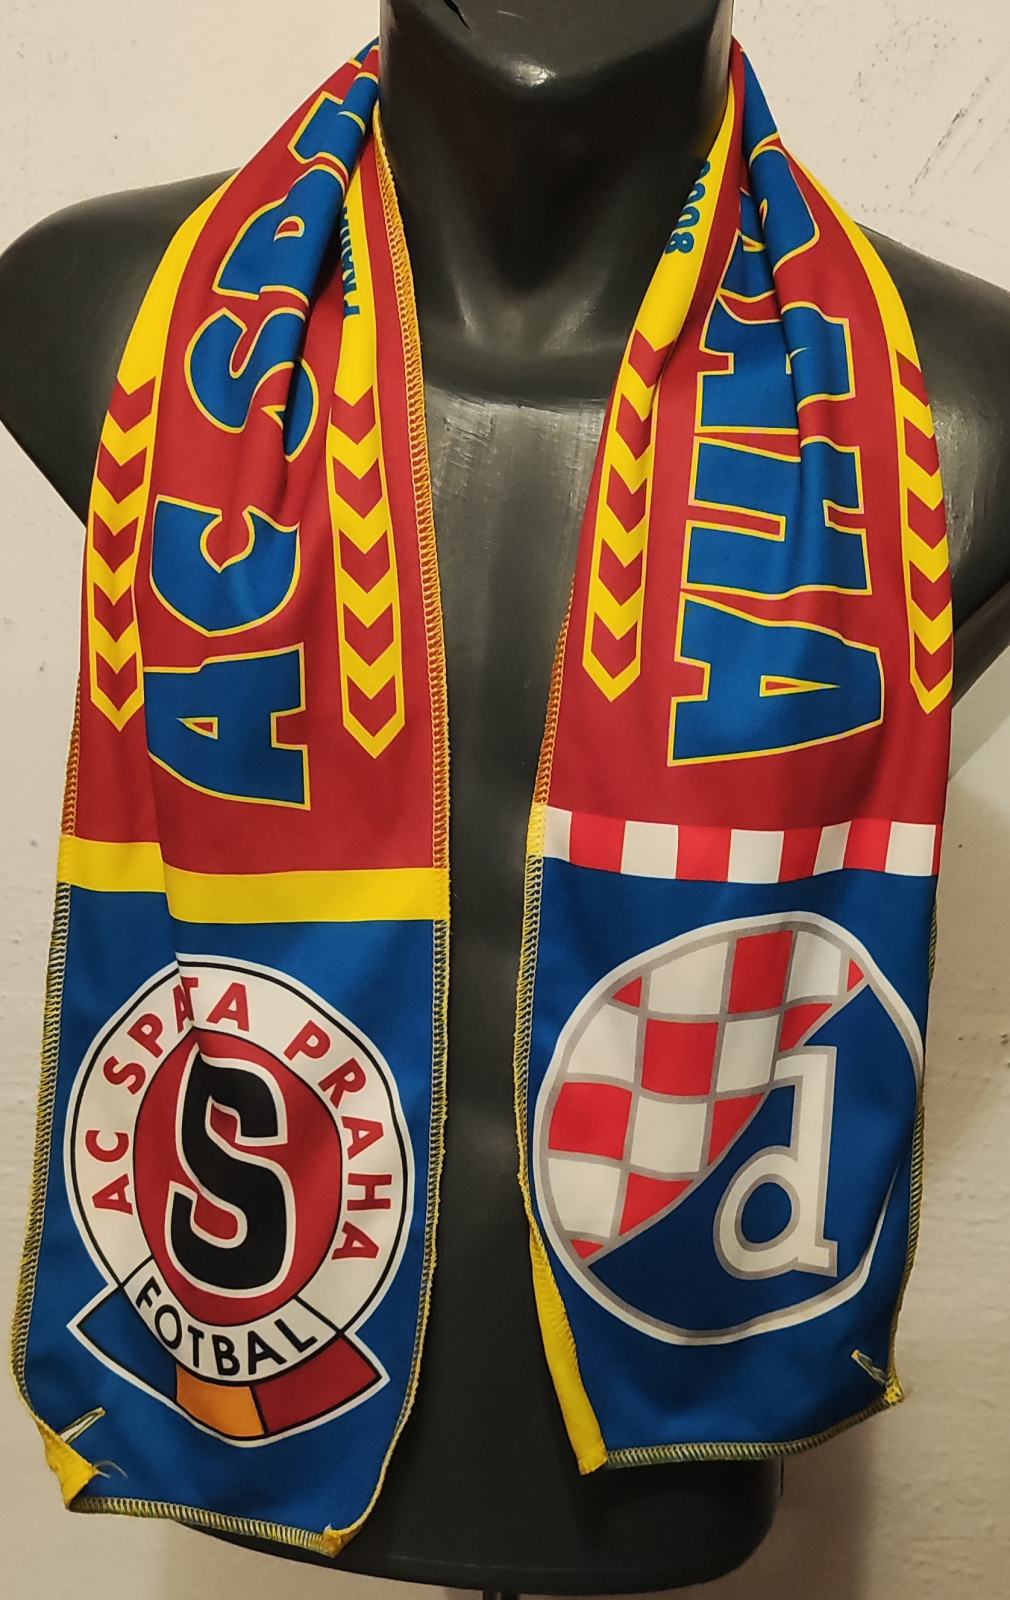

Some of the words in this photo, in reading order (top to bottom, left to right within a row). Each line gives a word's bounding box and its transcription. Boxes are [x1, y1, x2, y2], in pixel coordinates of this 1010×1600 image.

[143, 494, 311, 811] AC
[85, 1130, 133, 1216] AC
[283, 1020, 393, 1262] PRAHA
[135, 1276, 318, 1378] FOTBAL
